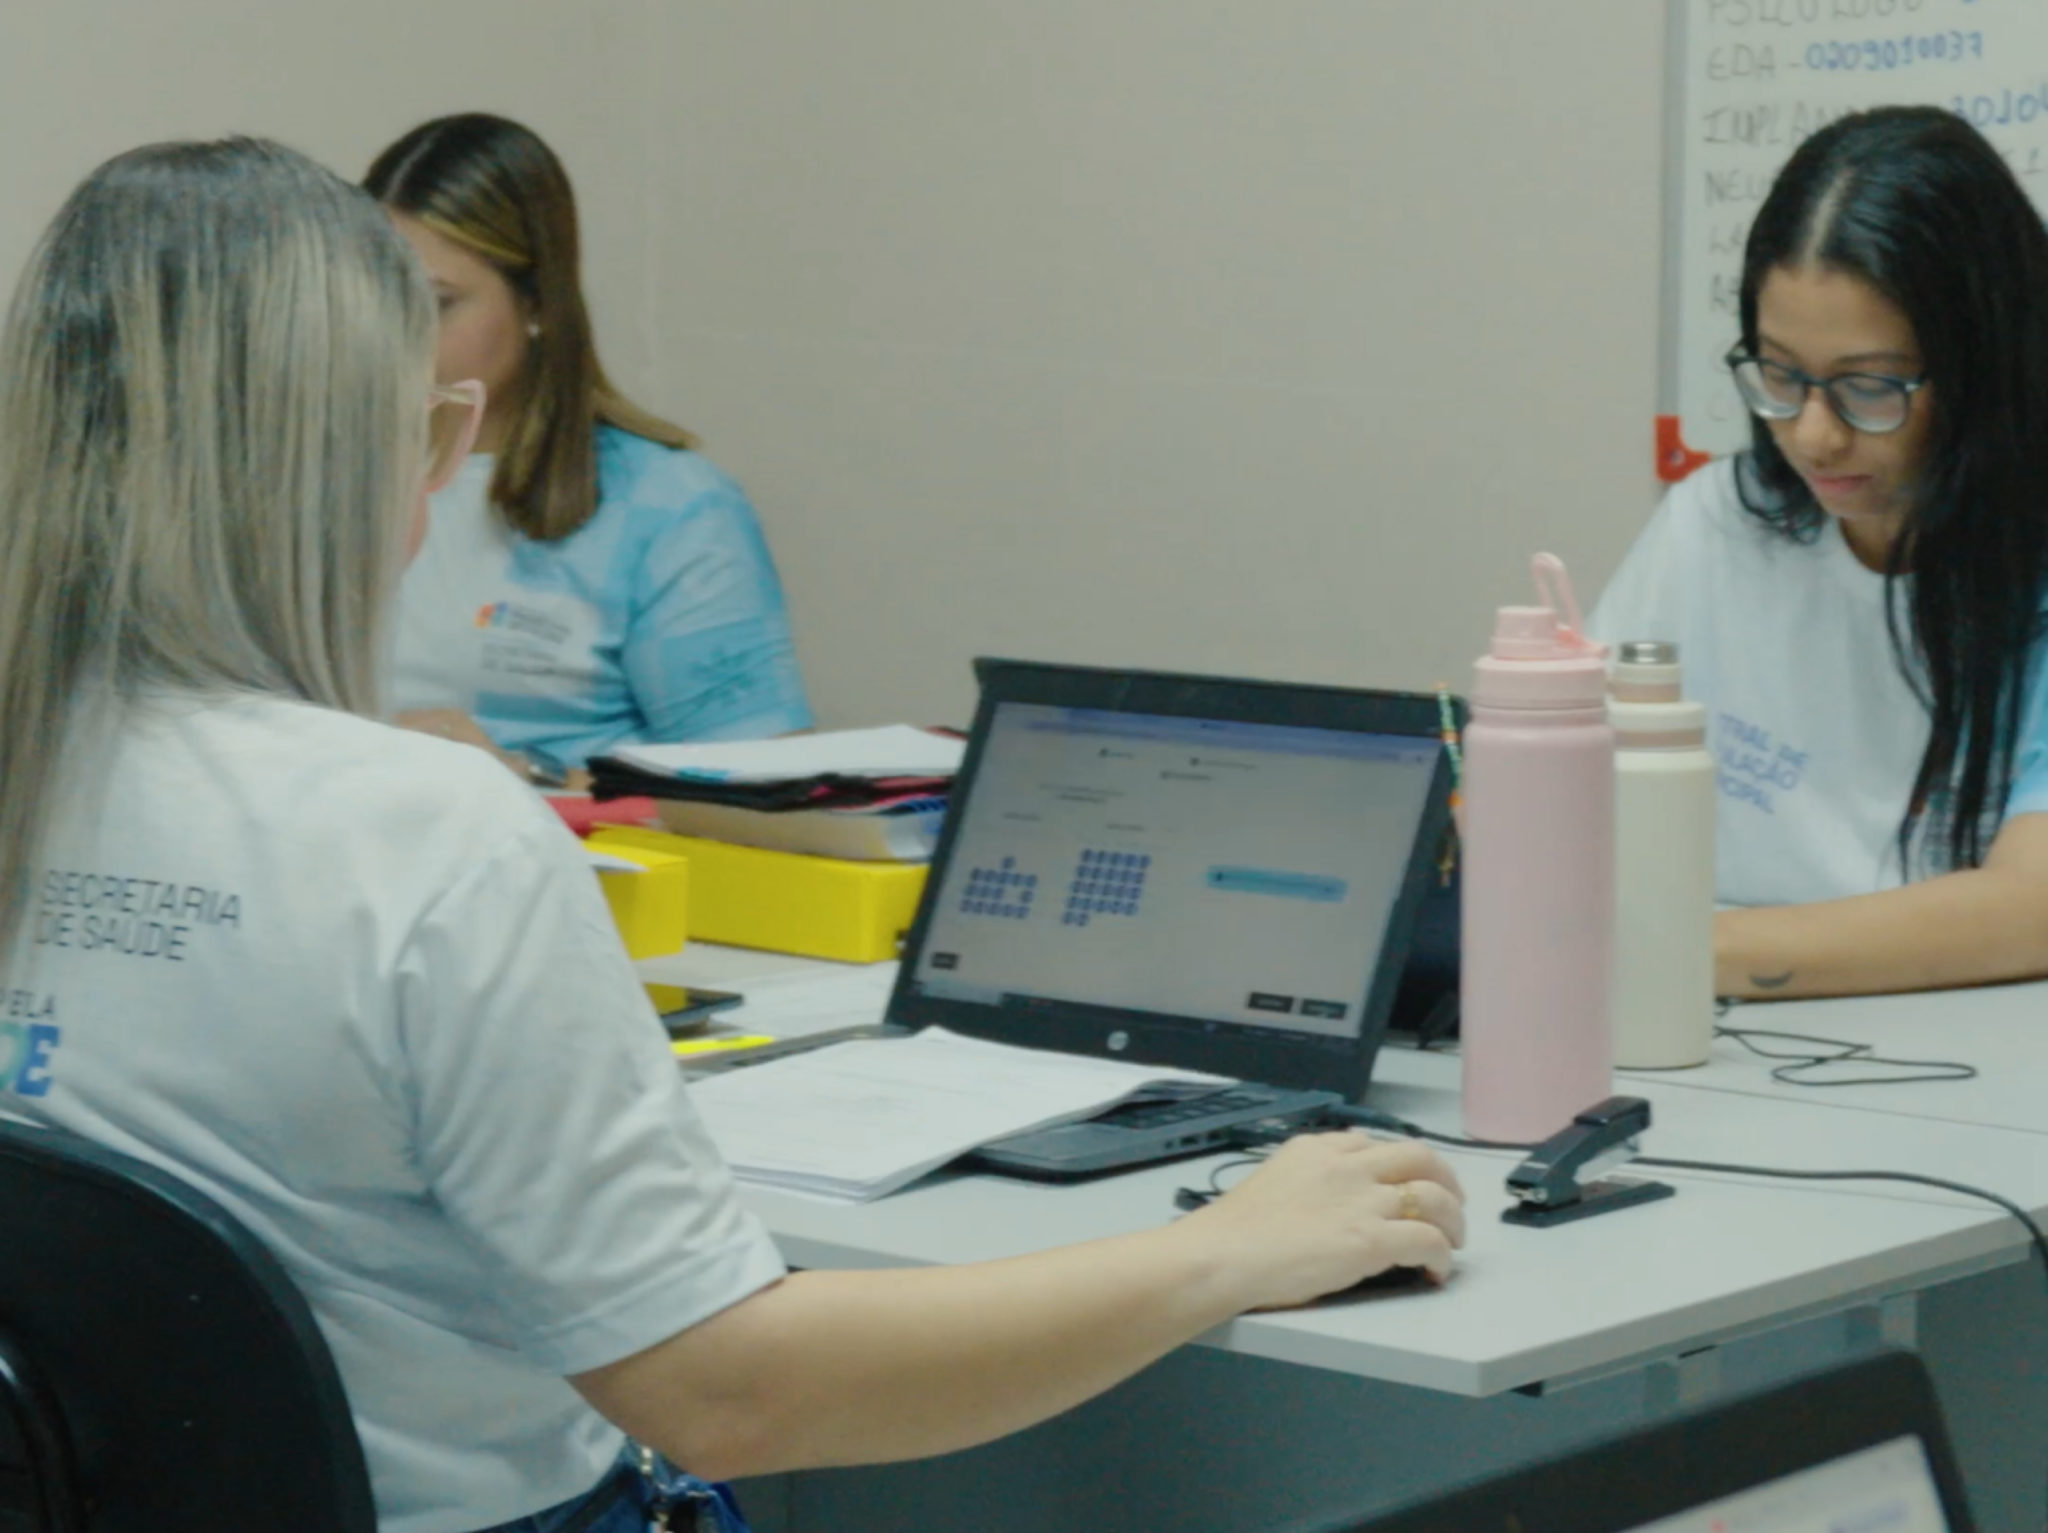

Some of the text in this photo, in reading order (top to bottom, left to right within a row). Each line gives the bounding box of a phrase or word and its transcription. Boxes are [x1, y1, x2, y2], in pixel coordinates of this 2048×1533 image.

[1707, 44, 1777, 80] EDA
[43, 868, 242, 930] SECRETARIA
[35, 910, 76, 948] DE
